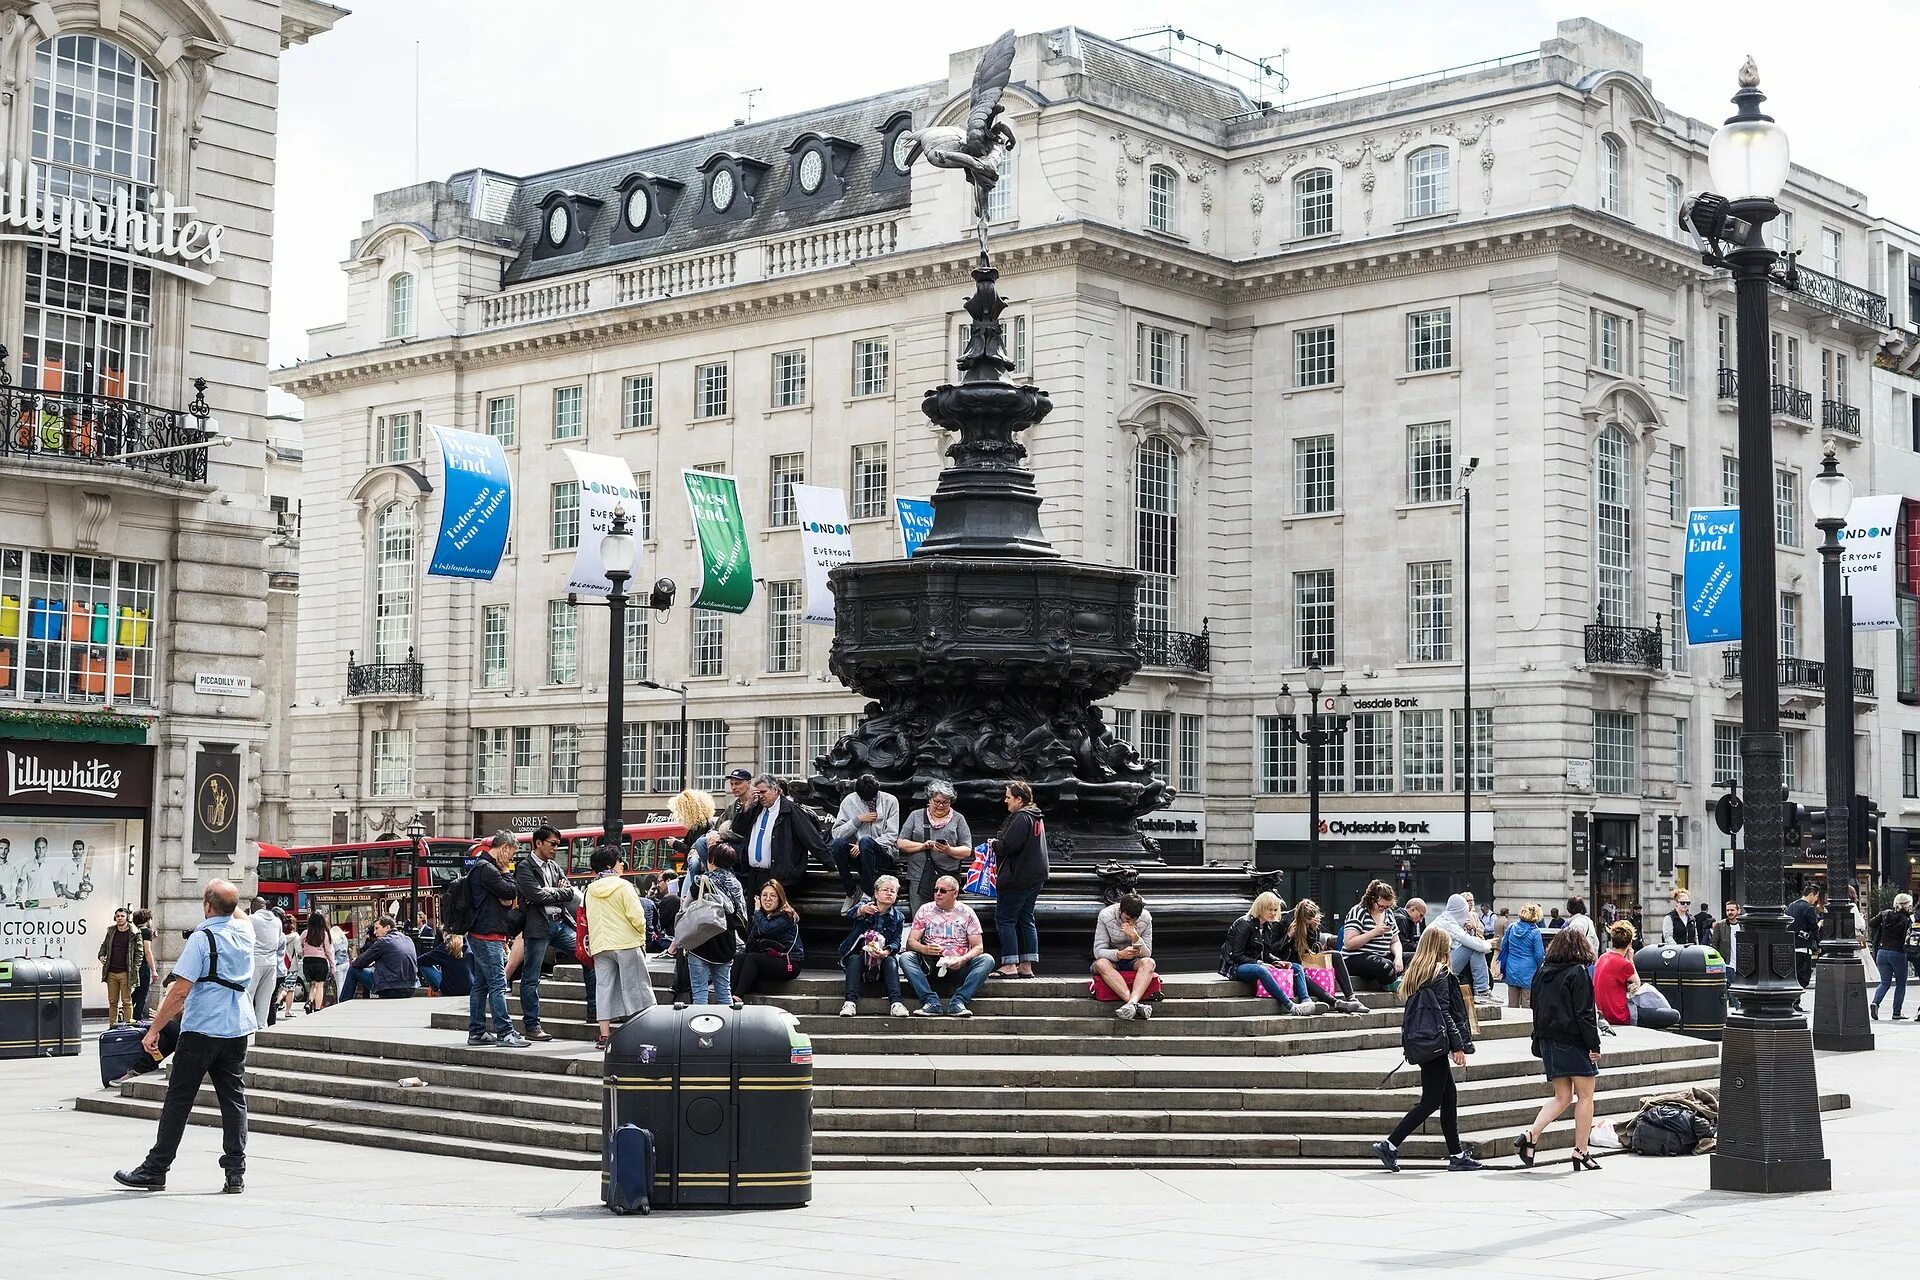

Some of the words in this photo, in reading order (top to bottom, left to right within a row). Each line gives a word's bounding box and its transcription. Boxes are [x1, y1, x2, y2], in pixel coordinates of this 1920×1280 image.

[443, 437, 493, 459] West
[448, 453, 493, 476] End.
[582, 480, 639, 500] LONDON
[690, 487, 729, 507] West
[692, 504, 730, 523] End.
[900, 502, 912, 510] The
[444, 506, 477, 539] Todos
[453, 525, 479, 551] bem
[478, 487, 507, 524] vindos
[590, 508, 637, 523] EVERNE
[902, 511, 934, 528] West
[1693, 513, 1709, 521] The
[592, 523, 634, 536] WELE
[802, 521, 851, 536] LONDON
[1692, 521, 1736, 537] West
[1836, 527, 1892, 541] ONDON
[813, 546, 851, 558] EVERYONE
[1688, 536, 1727, 553] End.
[817, 559, 842, 569] WELCO
[1842, 552, 1882, 562] ERYONE
[1841, 565, 1878, 574] ELCOME
[1692, 561, 1726, 612] Everyone
[1702, 570, 1733, 617] welcome
[200, 676, 234, 686] PICCADILLY
[236, 679, 246, 687] W1
[1353, 697, 1393, 710] desdale
[1394, 696, 1419, 708] Bank
[7, 750, 122, 798] Lillywhites
[511, 816, 543, 827] OSPREY
[1175, 819, 1199, 832] Bank
[1329, 820, 1397, 837] Clydesdale
[1398, 820, 1430, 834] Bank
[277, 896, 289, 907] 88
[4, 937, 37, 945] SINCE
[43, 936, 67, 945] 1881
